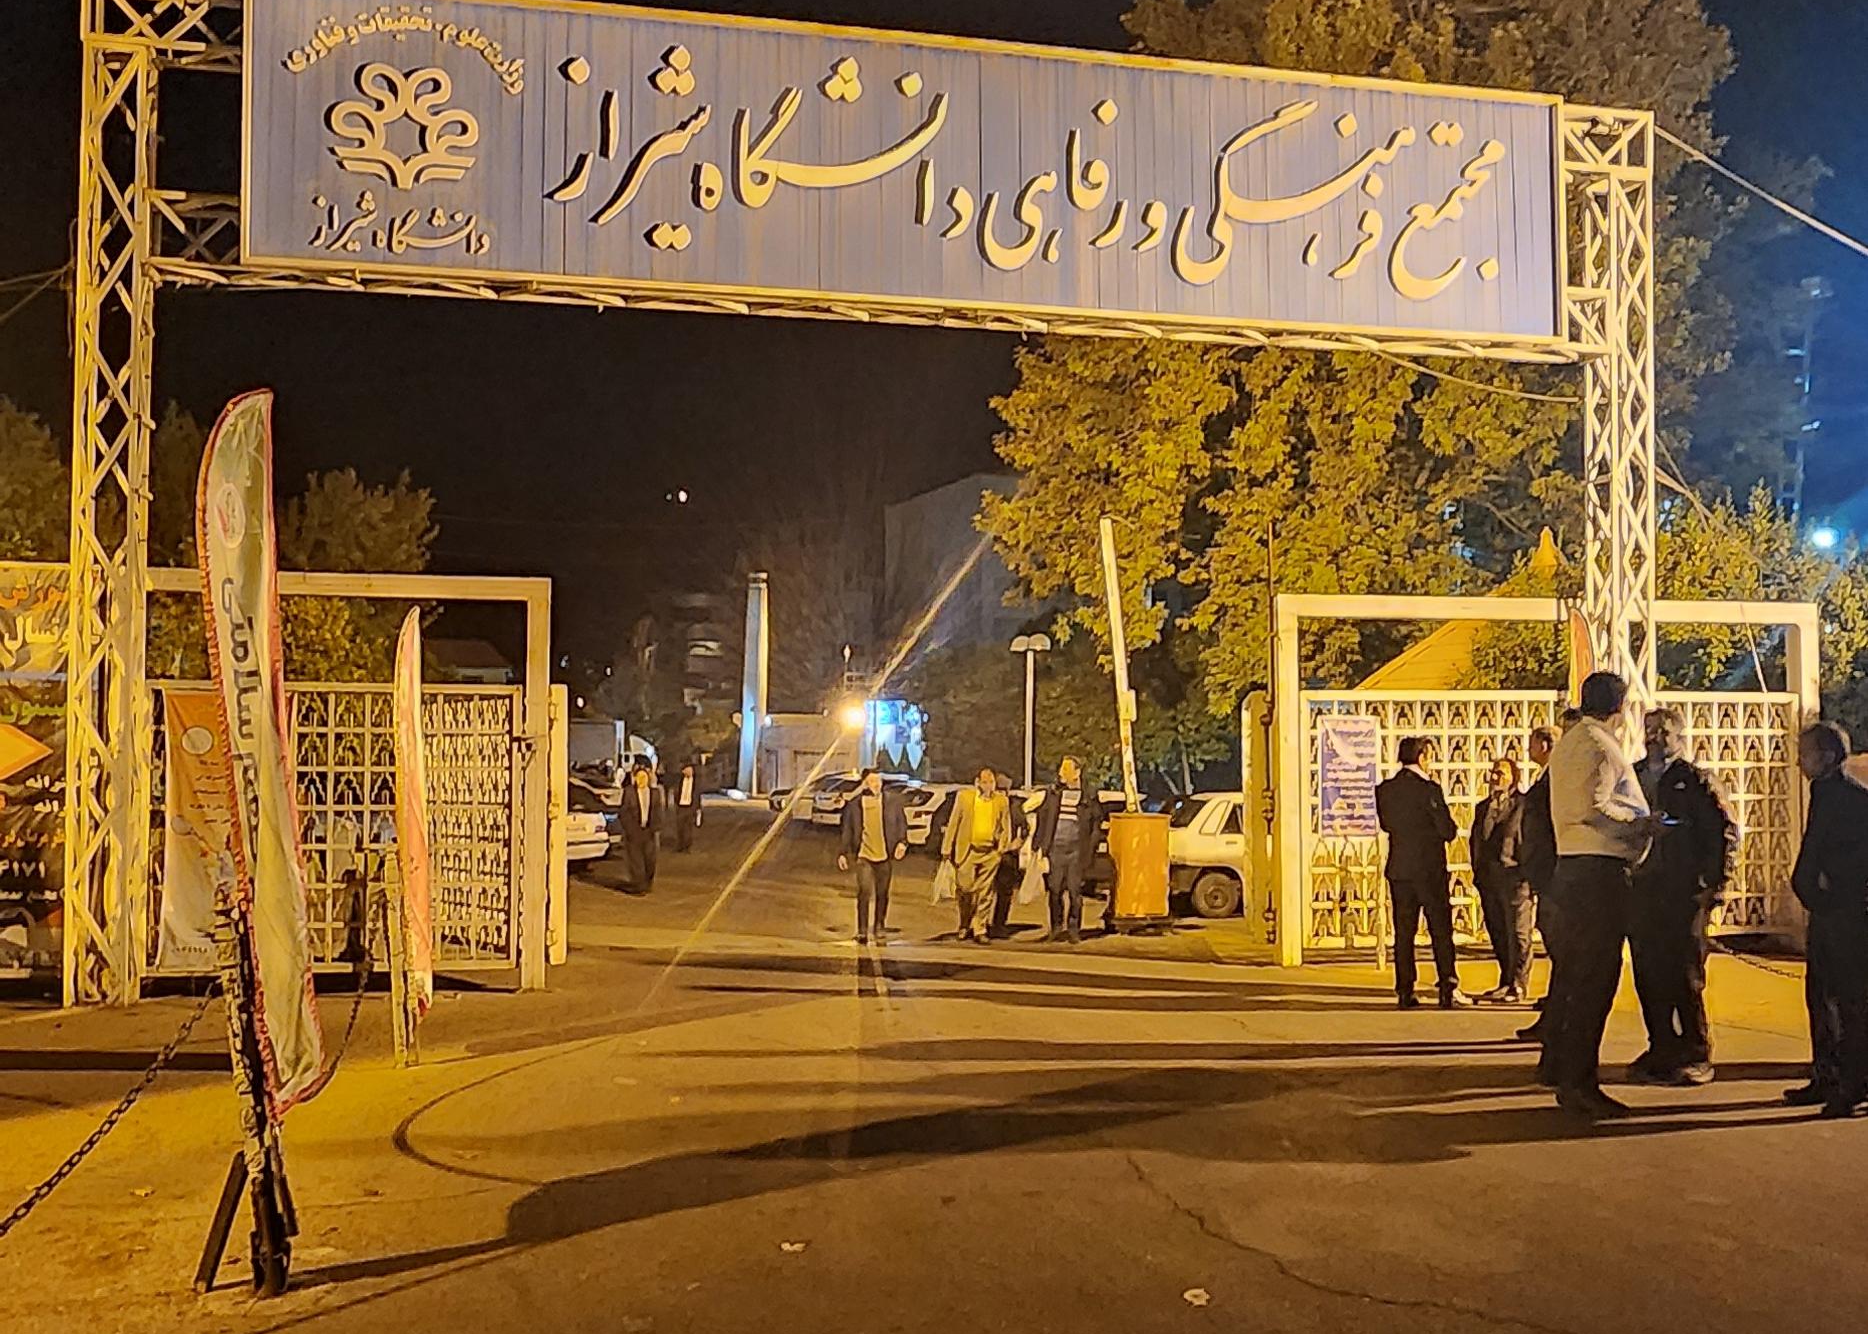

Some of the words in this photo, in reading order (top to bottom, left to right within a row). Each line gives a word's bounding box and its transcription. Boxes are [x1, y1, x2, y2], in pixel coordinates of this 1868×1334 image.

[286, 15, 346, 73] فناوری
[347, 25, 360, 46] و
[358, 6, 433, 42] تحقیقات
[484, 42, 525, 94] وزارت
[550, 44, 712, 251] شیراز
[694, 55, 974, 240] دانشگاه
[976, 98, 1128, 271] رفاهی
[1171, 99, 1415, 286] فرهنگی
[1391, 121, 1505, 300] مجتمع
[310, 190, 377, 253] شیراز
[374, 207, 491, 255] دانشگاه
[1130, 200, 1168, 252] و
